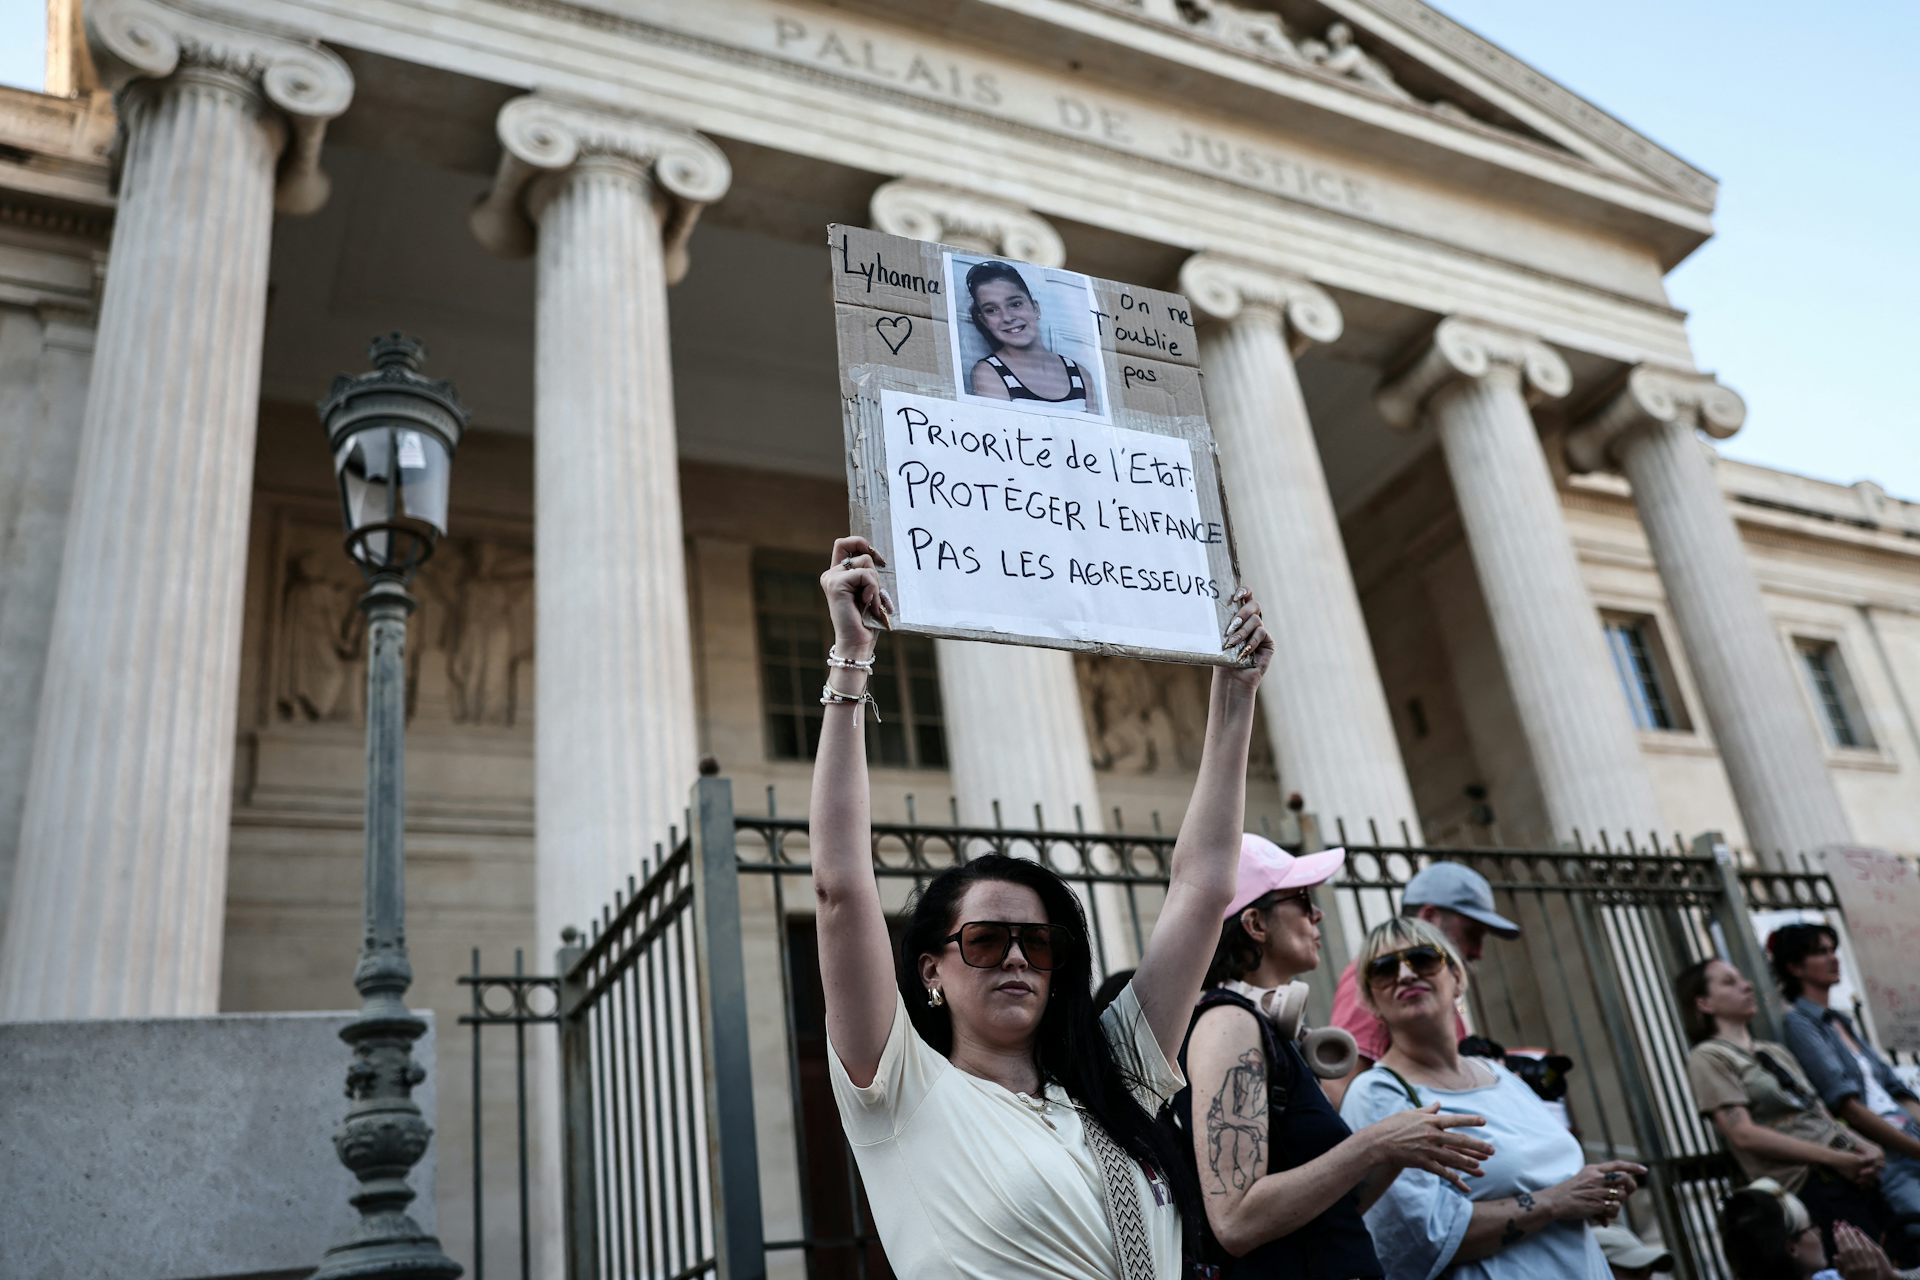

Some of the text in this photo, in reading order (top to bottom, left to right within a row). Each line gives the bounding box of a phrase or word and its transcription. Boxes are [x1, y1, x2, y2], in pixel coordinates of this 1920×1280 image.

[774, 18, 1373, 213] PALAIS DE JUSTICE
[843, 233, 942, 295] Lyhanna
[1120, 293, 1196, 327] On ne
[1123, 365, 1157, 390] pas
[1066, 438, 1102, 474] de
[898, 460, 1222, 544] PROTÉGER L'ENFANCE
[908, 527, 1221, 600] PAS LES AGRESSEURS
